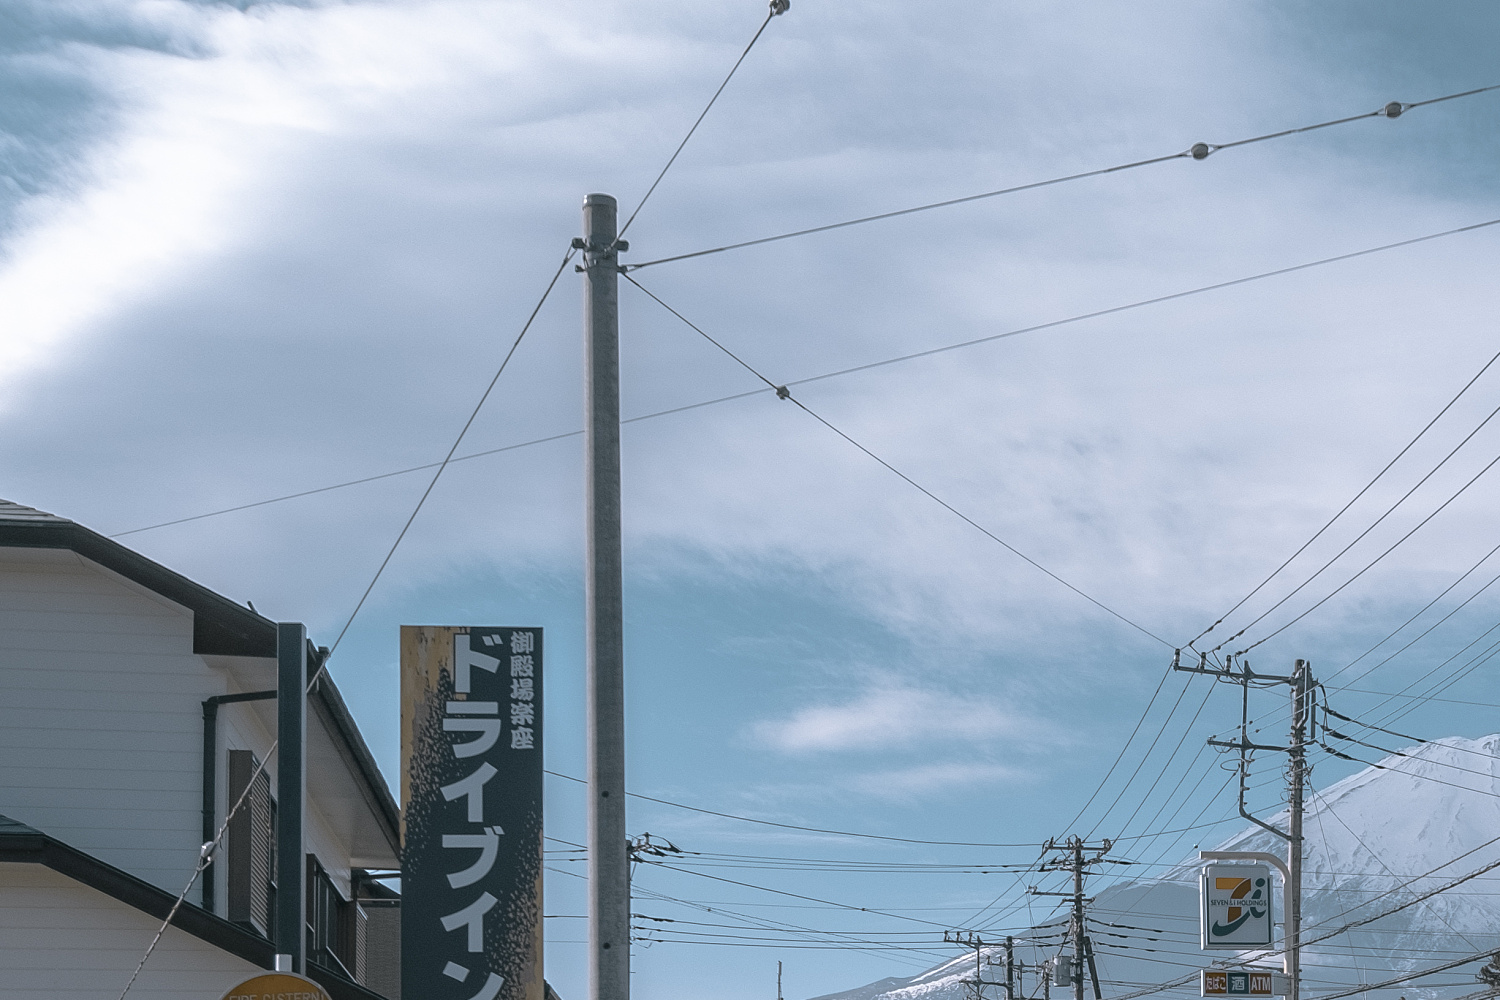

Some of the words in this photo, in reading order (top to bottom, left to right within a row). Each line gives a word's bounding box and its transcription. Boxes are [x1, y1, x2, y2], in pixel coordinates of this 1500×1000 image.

[510, 631, 535, 750] 御殿場楽座
[1206, 976, 1226, 990] たばこ
[1232, 976, 1245, 990] 酒
[1251, 976, 1271, 991] ATM
